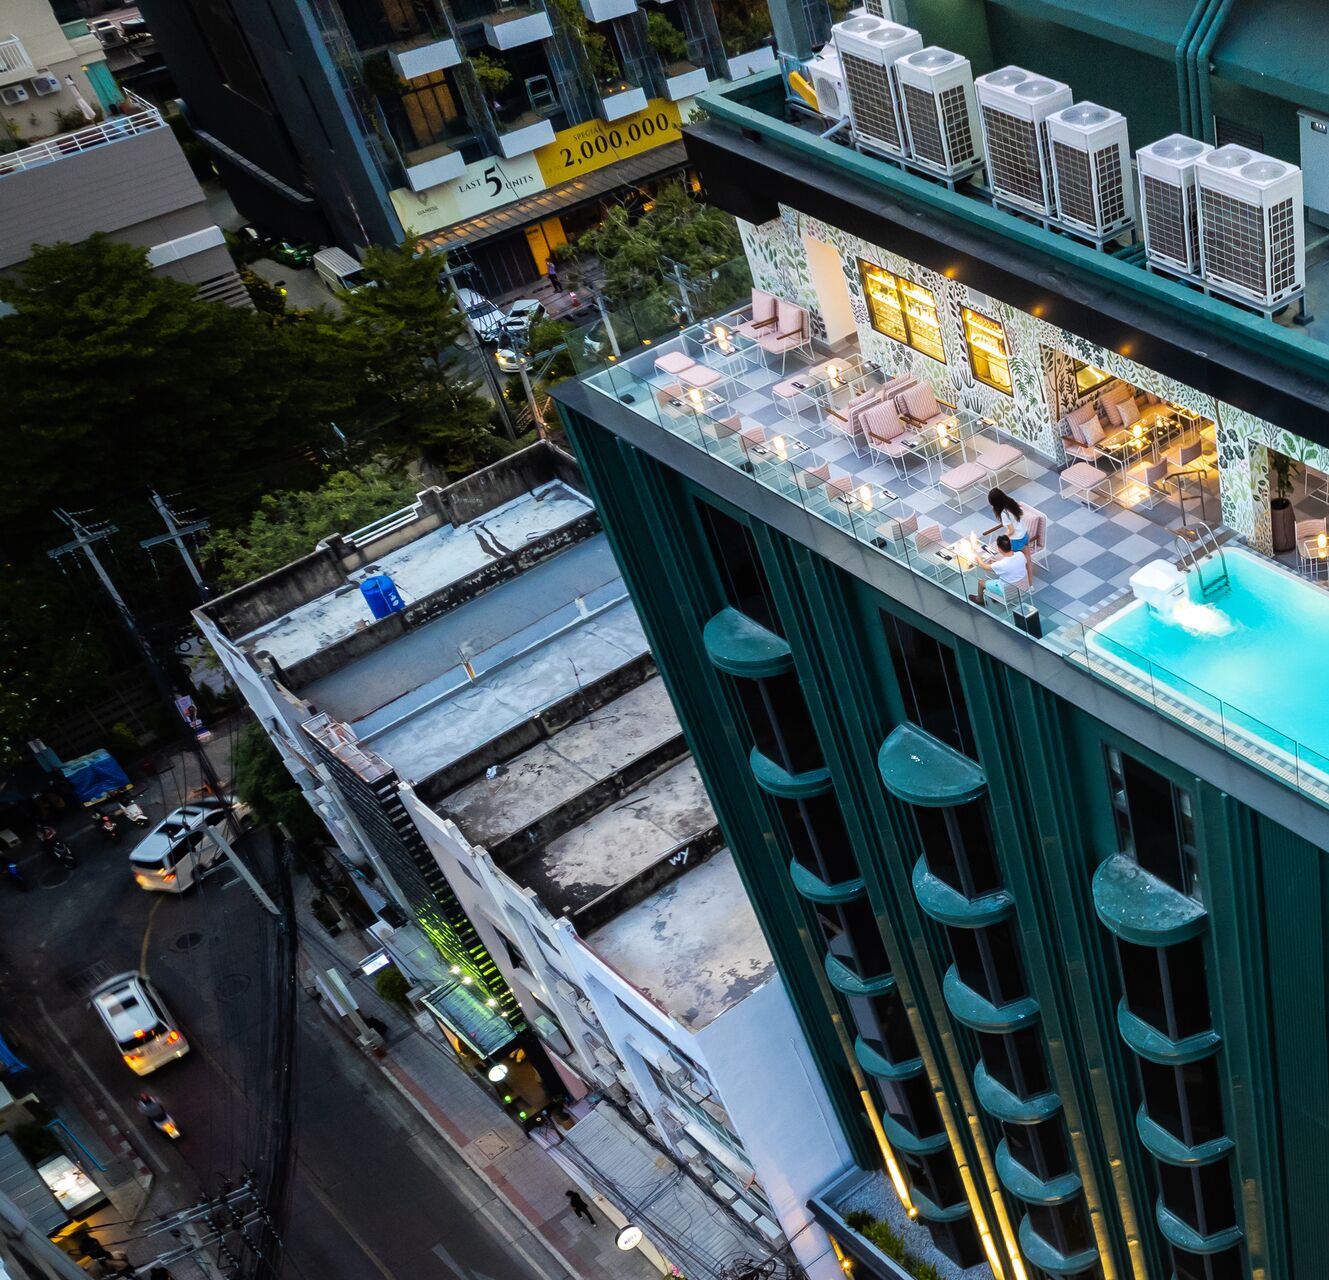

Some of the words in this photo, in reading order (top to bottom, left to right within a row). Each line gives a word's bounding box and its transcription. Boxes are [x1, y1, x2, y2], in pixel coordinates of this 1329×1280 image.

[560, 112, 669, 168] 2,000,000
[458, 179, 481, 193] LAST
[484, 165, 502, 198] 5
[505, 173, 534, 190] UNITS
